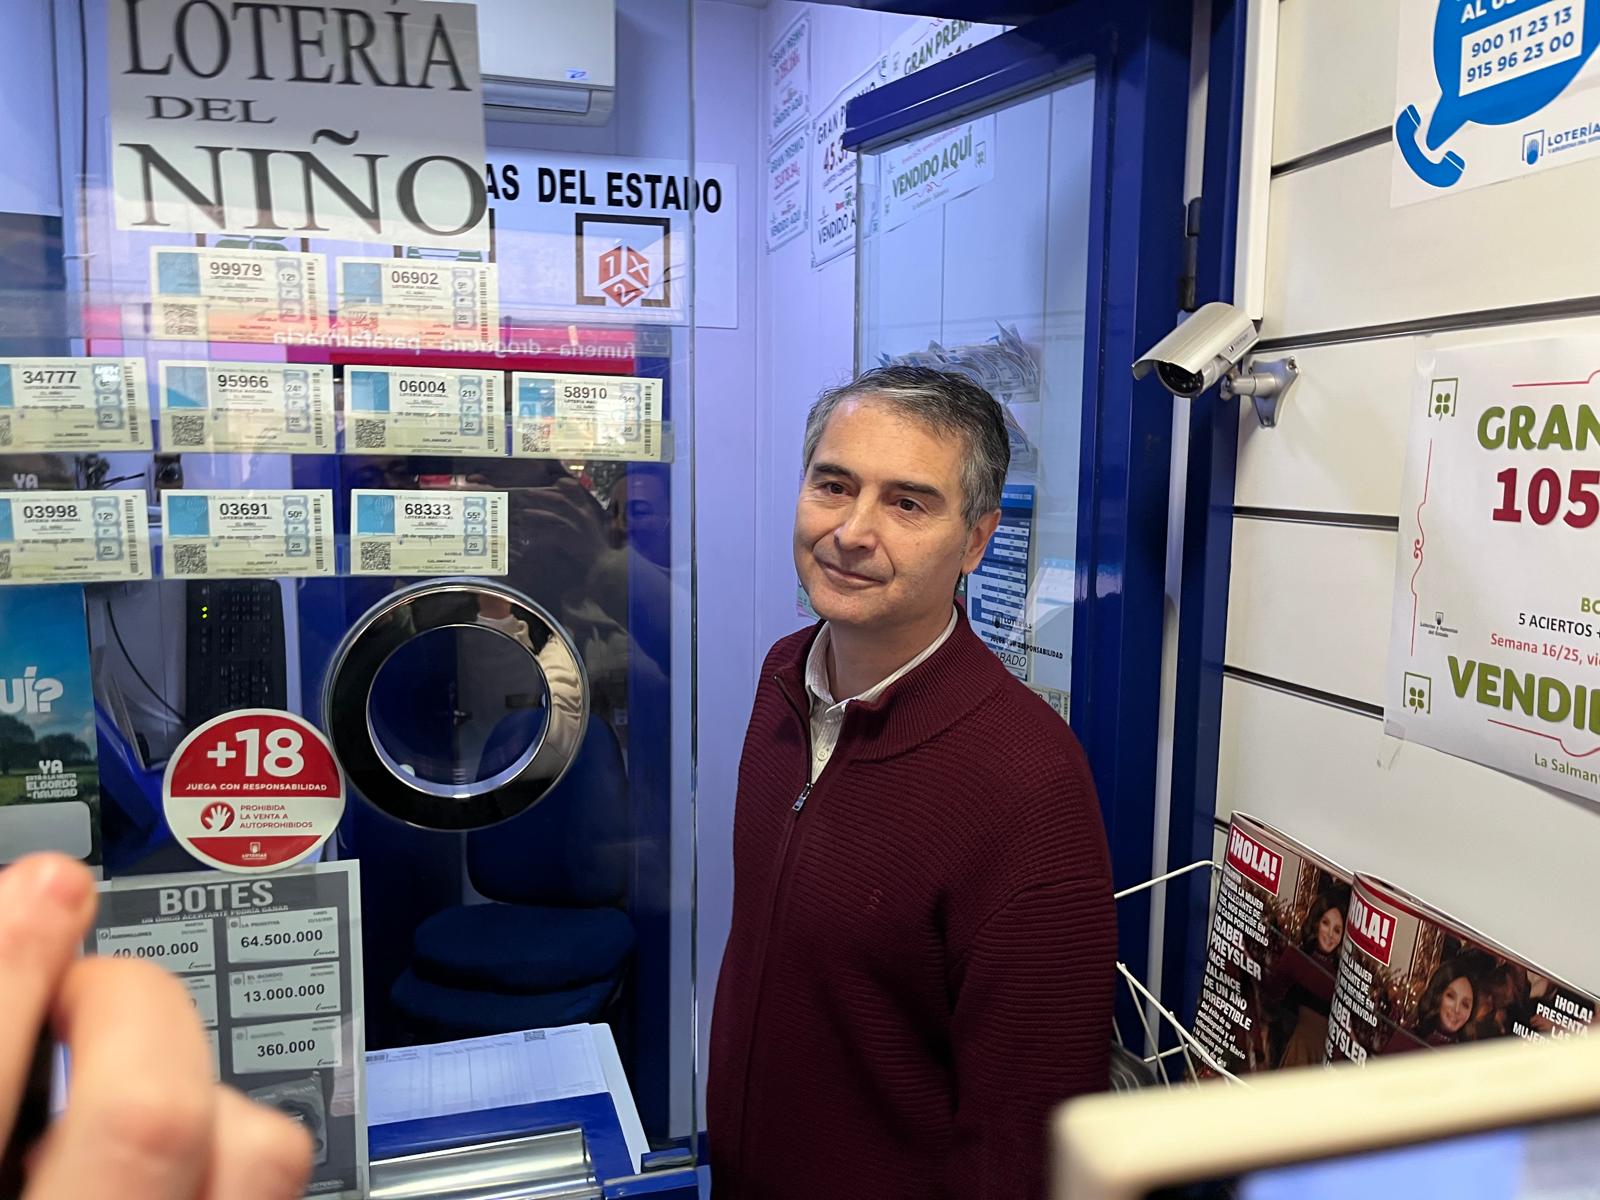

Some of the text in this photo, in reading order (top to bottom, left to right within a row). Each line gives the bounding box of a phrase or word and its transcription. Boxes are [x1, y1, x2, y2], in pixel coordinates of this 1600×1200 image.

[1461, 2, 1488, 24] AL
[122, 0, 473, 92] LOTERÍA
[1472, 6, 1572, 58] 900 11 23 13
[1467, 31, 1574, 83] 915 96 23 00
[146, 95, 277, 123] DEL
[892, 154, 939, 198] VENDIDO
[941, 124, 972, 172] AQUÍ
[119, 128, 488, 237] NIÑO
[538, 167, 595, 205] DEL
[606, 172, 722, 214] ESTADO
[210, 261, 263, 277] 99979
[391, 270, 439, 285] 06902
[22, 370, 77, 384] 34777
[217, 374, 269, 388] 95966
[399, 380, 447, 394] 06004
[563, 386, 608, 400] 58910
[13, 473, 39, 489] YA
[23, 504, 78, 519] 03998
[219, 503, 268, 516] 03691
[404, 503, 451, 515] 68333
[1492, 467, 1600, 529] 105
[1518, 612, 1593, 637] 5 ACIERTOS
[1490, 633, 1538, 654] Semana
[1542, 643, 1583, 666] 16/25,
[206, 728, 305, 778] +18
[39, 760, 63, 775] YA
[1534, 752, 1600, 786] La Salman
[186, 783, 327, 791] JUEGA CON RESPONSABILIDAD
[240, 804, 286, 812] PROHIBIDA
[240, 813, 251, 821] LA
[240, 821, 313, 829] AUTOPROHIBIDOS
[1230, 829, 1278, 881] ¡HOLA!
[159, 880, 274, 916] BOTES
[240, 929, 323, 948] 64.500.000
[1213, 913, 1245, 951] ISABEL
[1233, 915, 1245, 931] POR
[1245, 924, 1268, 947] NAVIDAD
[1258, 922, 1266, 935] EN
[1210, 929, 1261, 981] PREYSLER
[1205, 960, 1241, 992] BALANCE
[244, 983, 325, 1003] 13.000.000
[1203, 973, 1247, 1011] DE UN AÑO
[1202, 987, 1252, 1031] IRREPETIBLE
[1352, 1000, 1378, 1028] NAVIDAD
[1536, 1002, 1588, 1040] PRESENTA
[1554, 994, 1594, 1024] ¡HOLA!
[257, 1039, 315, 1058] 360.000
